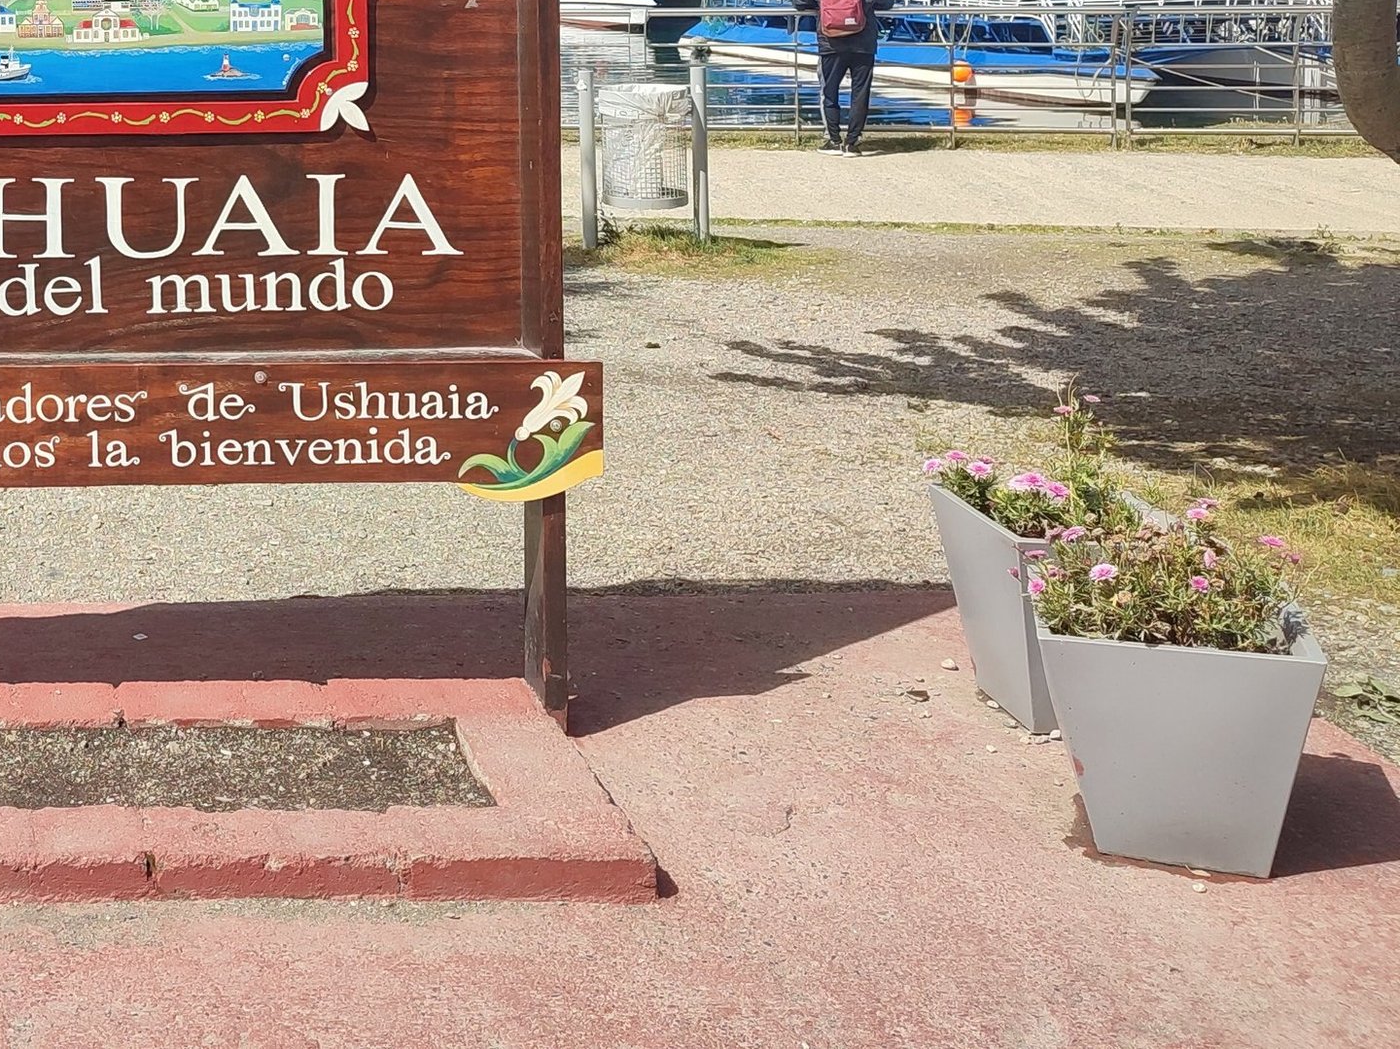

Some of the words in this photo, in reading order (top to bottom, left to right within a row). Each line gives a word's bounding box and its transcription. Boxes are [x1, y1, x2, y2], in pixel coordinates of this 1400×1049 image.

[145, 257, 394, 316] mundo
[178, 382, 256, 422] de
[277, 381, 500, 422] Ushuaia
[86, 429, 141, 469] la
[158, 426, 452, 468] bienvenida
